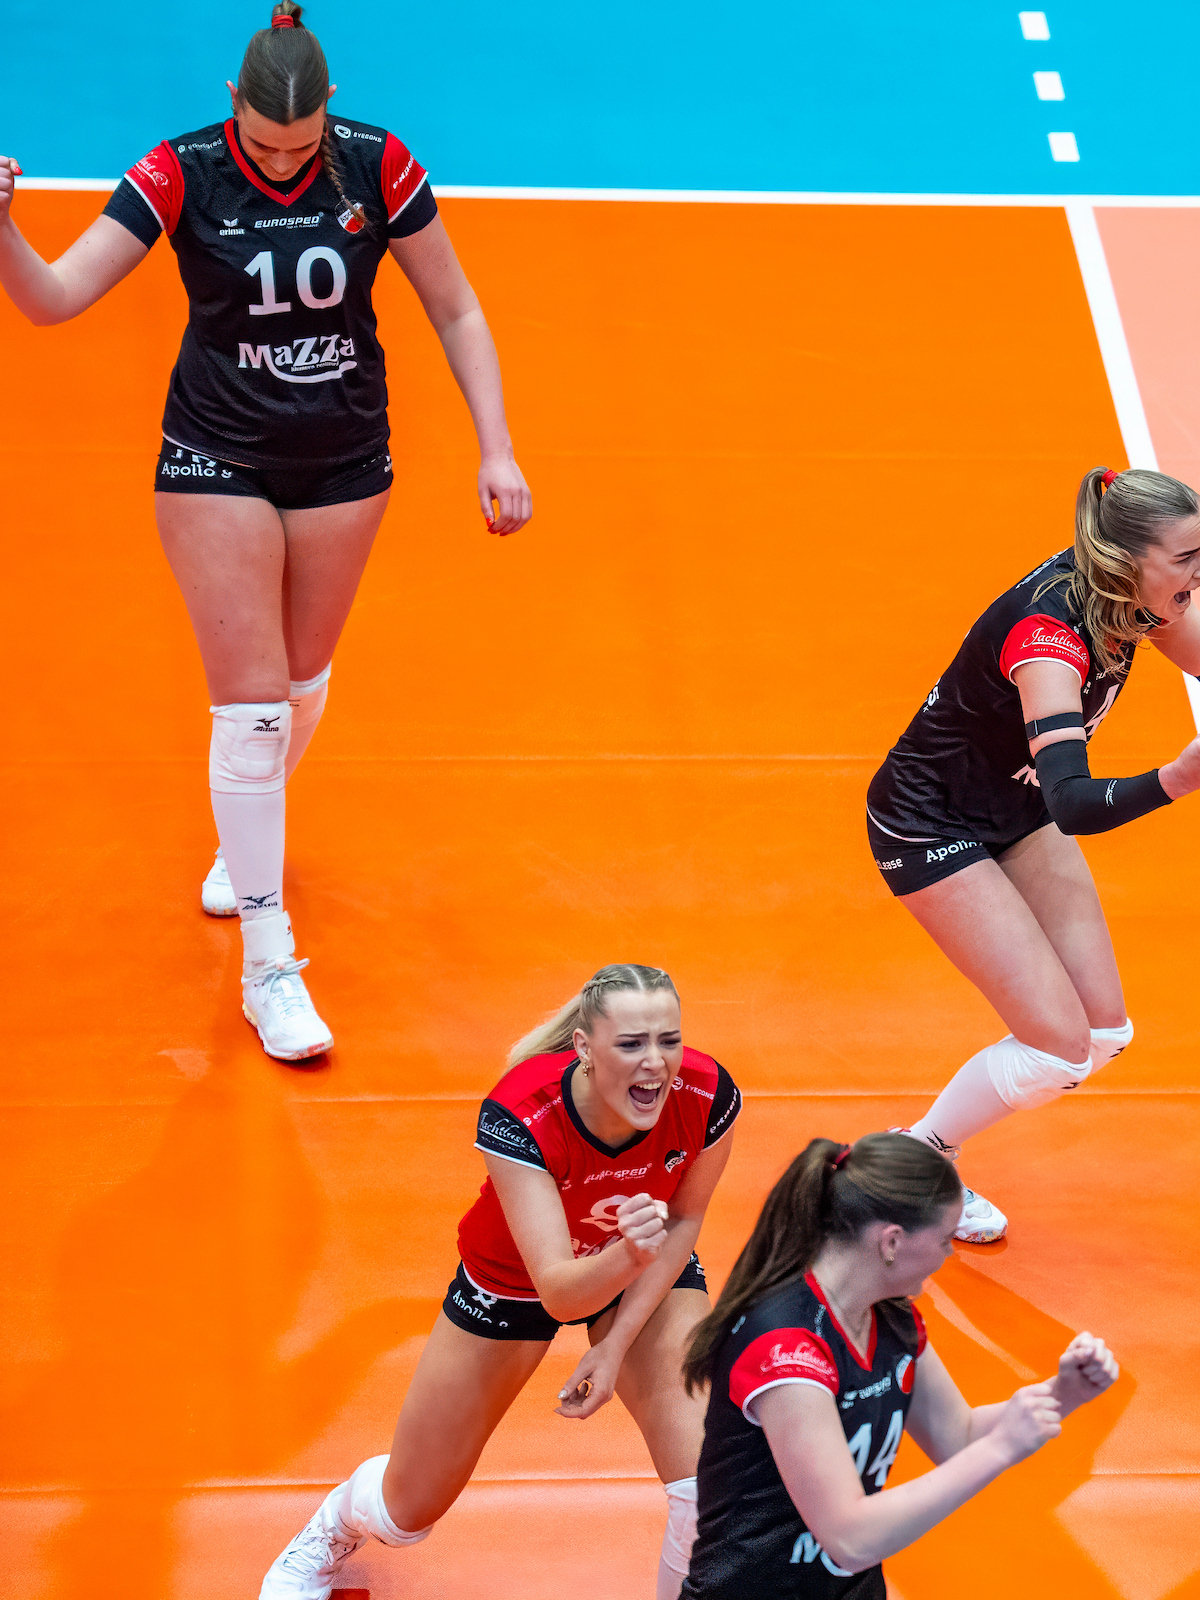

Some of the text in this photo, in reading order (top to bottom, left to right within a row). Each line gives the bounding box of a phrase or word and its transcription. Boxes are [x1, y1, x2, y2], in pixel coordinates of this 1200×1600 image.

[254, 215, 320, 229] EUROSPED
[219, 228, 245, 236] erima
[243, 245, 347, 316] 10
[161, 461, 216, 479] Apollo
[848, 1409, 904, 1487] 14
